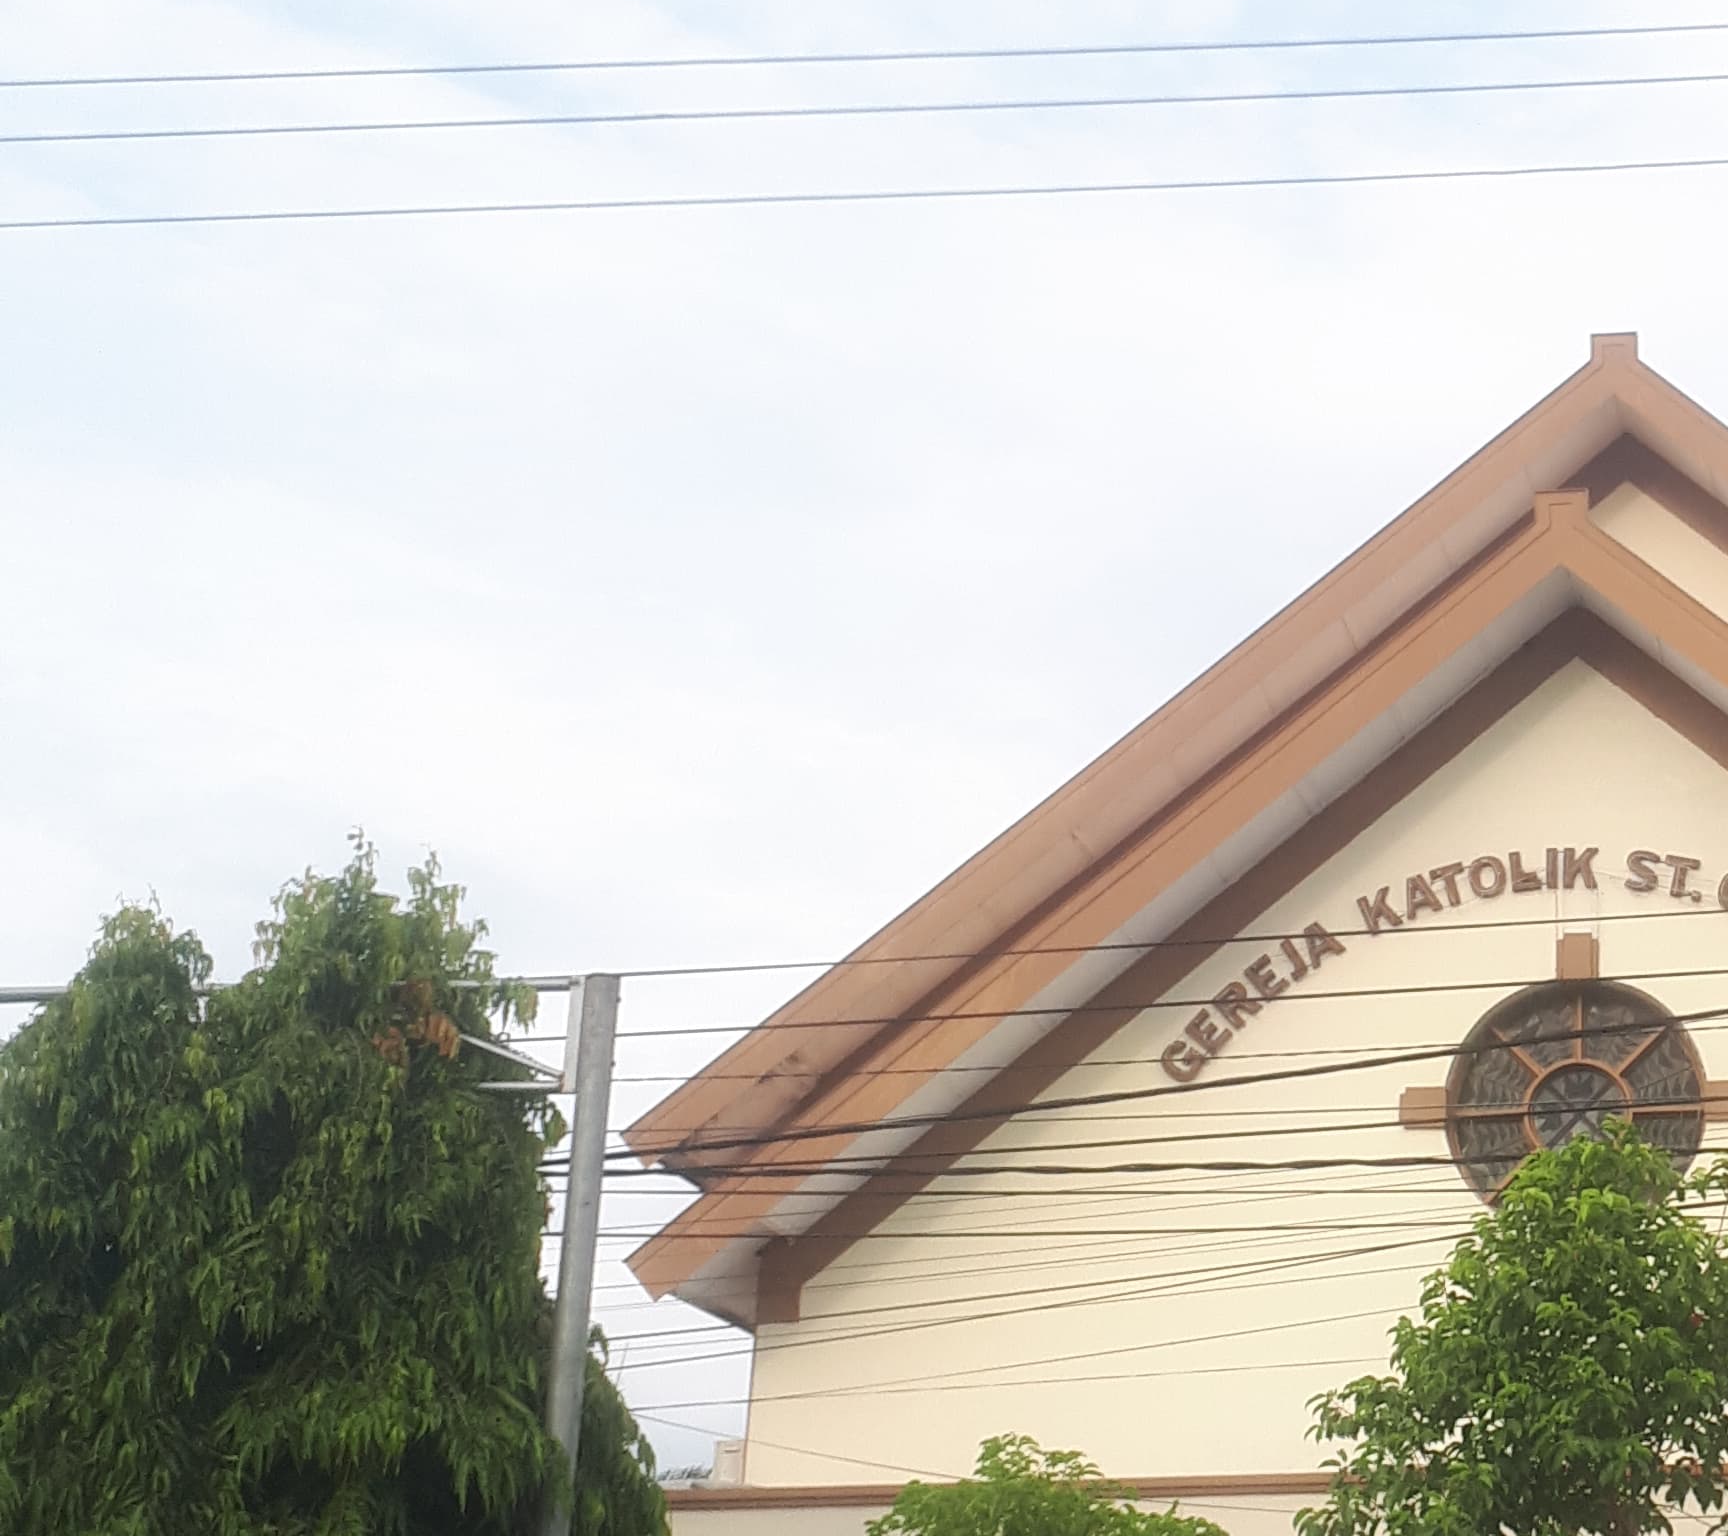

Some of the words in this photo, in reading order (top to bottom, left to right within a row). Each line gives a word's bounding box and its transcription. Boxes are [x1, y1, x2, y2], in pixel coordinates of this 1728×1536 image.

[1160, 921, 1347, 1083] GEREJA
[1356, 846, 1599, 935] KATOLIK
[1623, 849, 1702, 902] ST.
